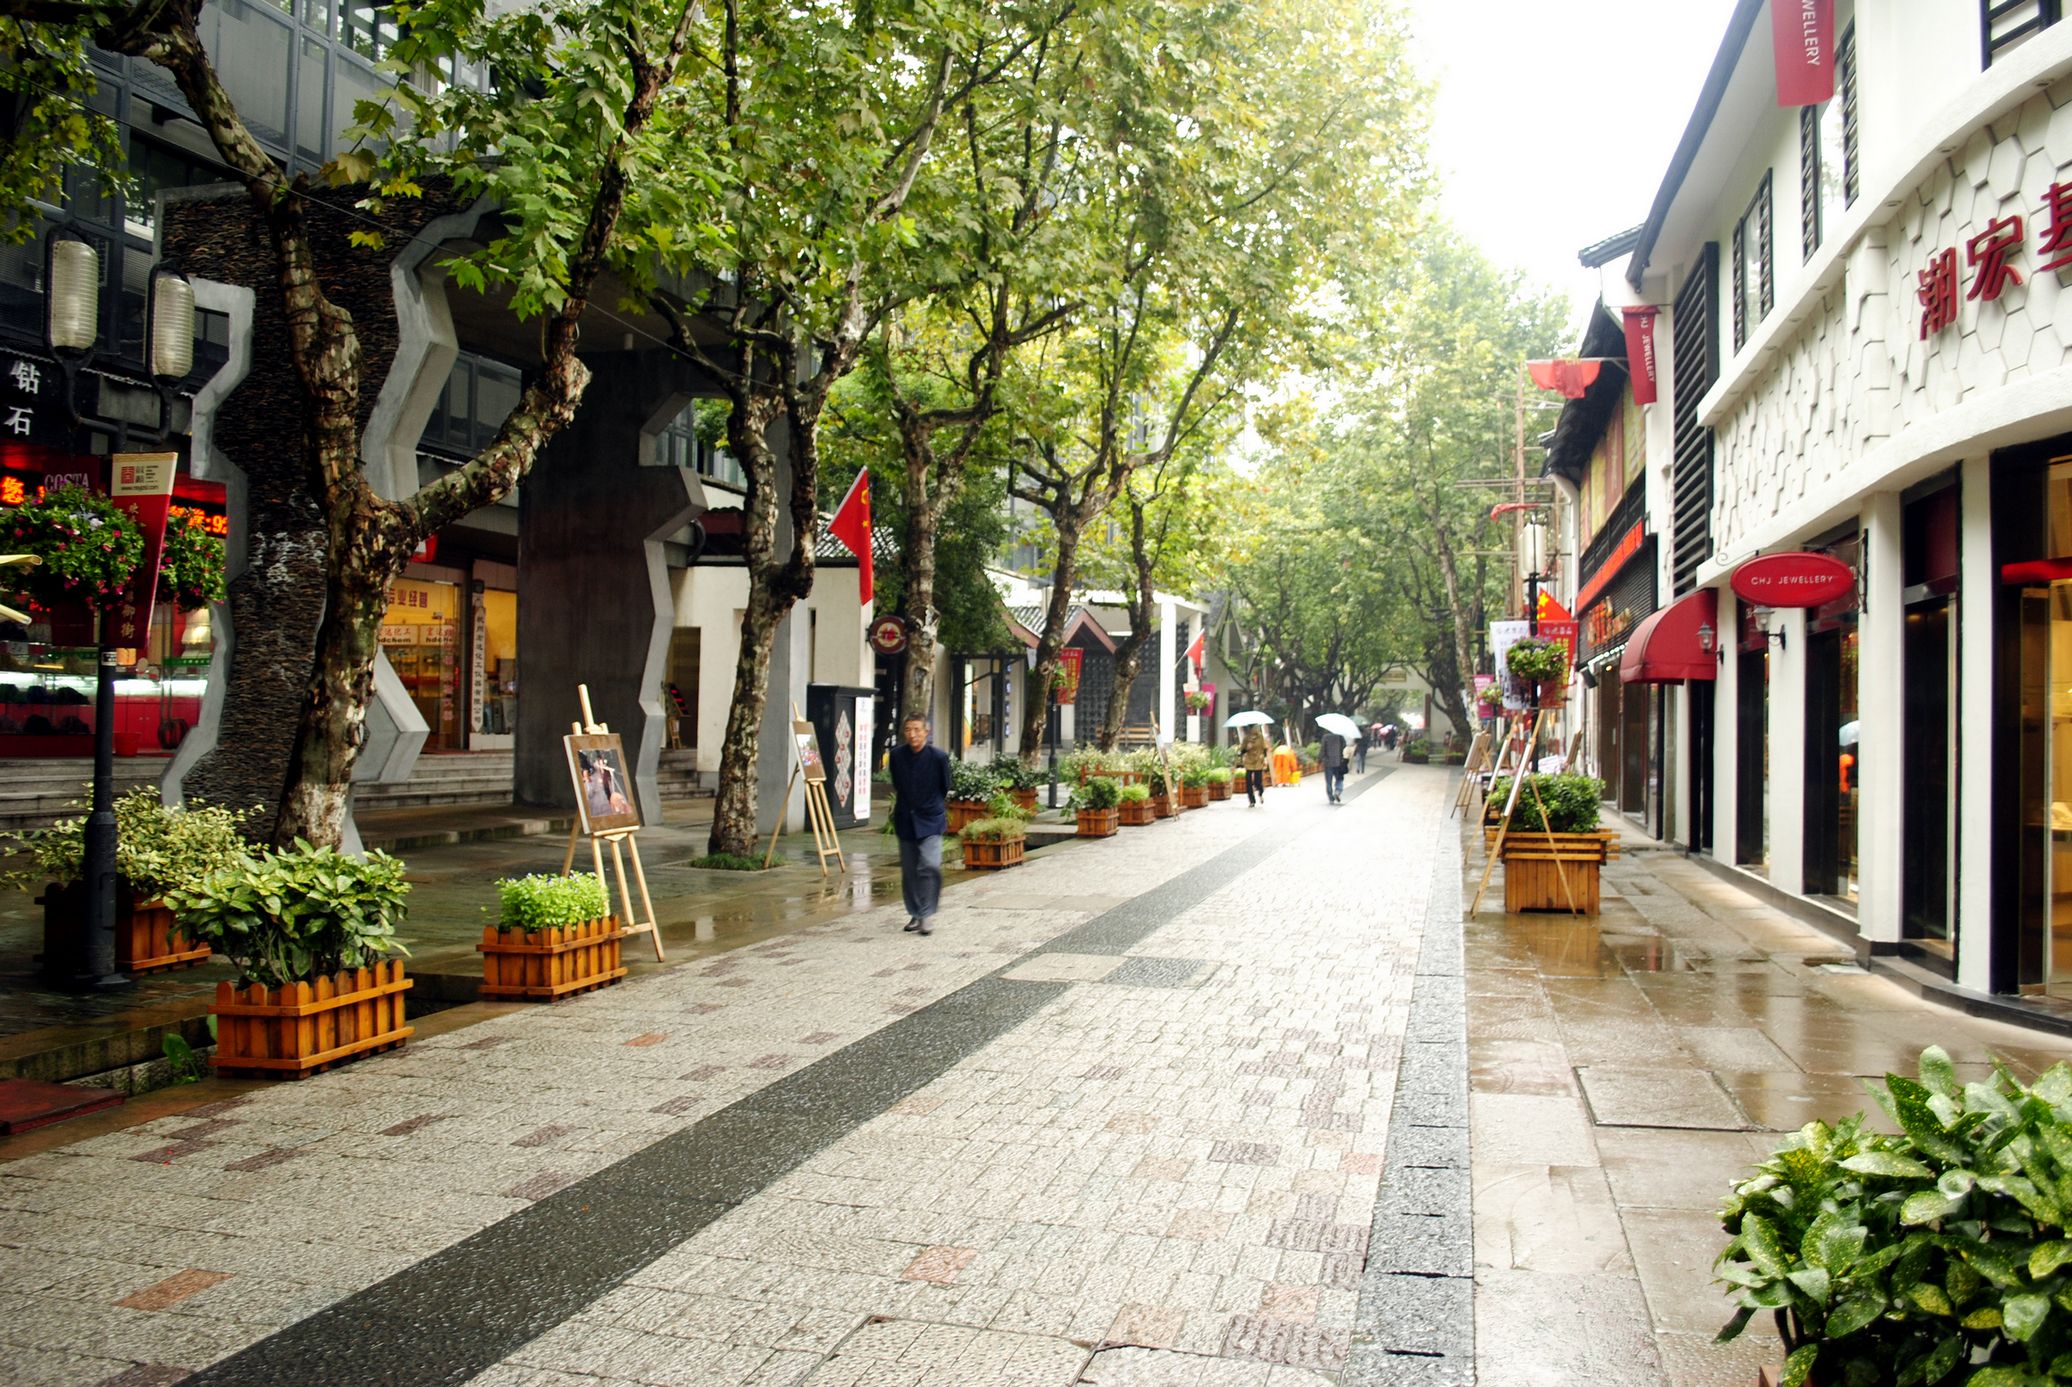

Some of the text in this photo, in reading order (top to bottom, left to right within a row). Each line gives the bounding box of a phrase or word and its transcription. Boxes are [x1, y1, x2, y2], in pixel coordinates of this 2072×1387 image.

[1642, 334, 1656, 382] JEWELLERY
[4, 361, 41, 436] 钻石
[1751, 575, 1833, 585] CHJ JEWELLERY
